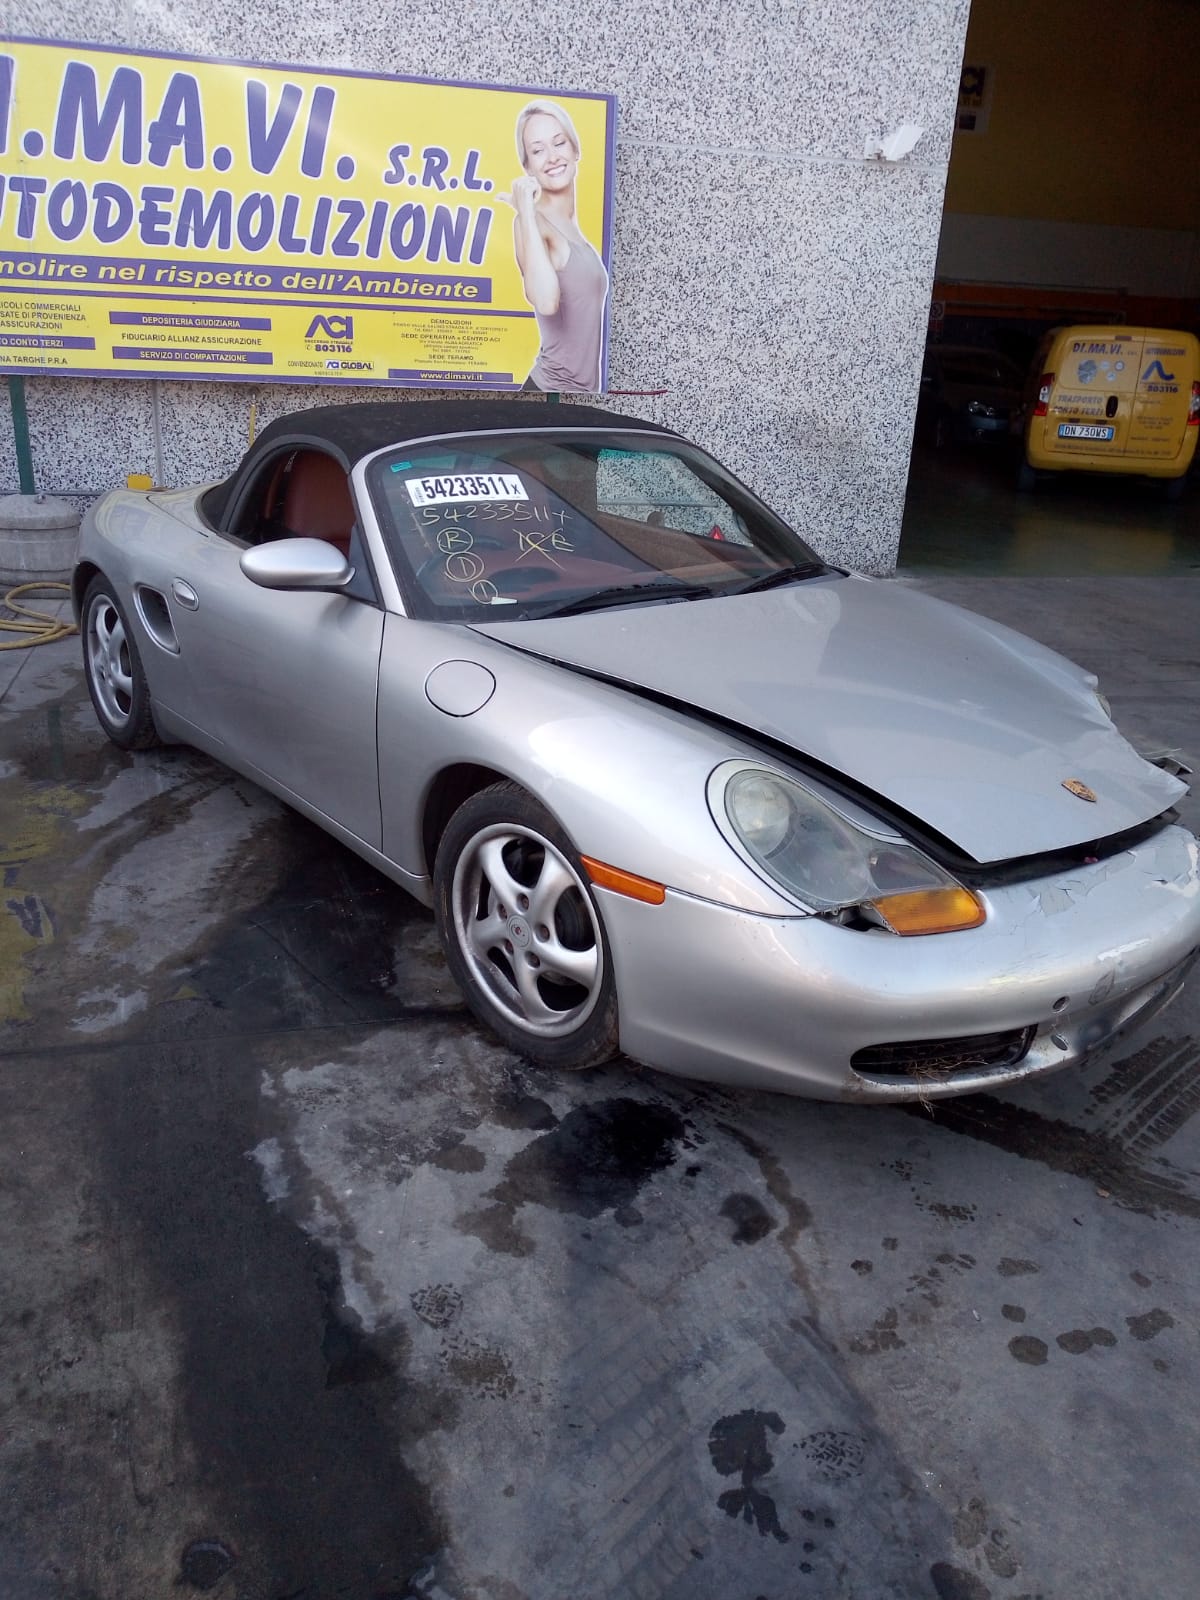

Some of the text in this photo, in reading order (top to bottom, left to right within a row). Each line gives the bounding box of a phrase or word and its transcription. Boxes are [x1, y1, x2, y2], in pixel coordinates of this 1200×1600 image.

[384, 144, 493, 191] S.R.L.
[98, 264, 146, 281] nel
[155, 265, 272, 288] rispetto
[24, 302, 81, 312] COMMERCIALI
[31, 312, 86, 321] PROVENIENZA
[1, 320, 63, 329] ASSICURAZIONI
[142, 316, 241, 328] DEPOSITERIA GIUDIZIARIA
[304, 314, 354, 340] ACI
[10, 338, 39, 346] CONTO
[41, 339, 64, 347] TERZI
[121, 332, 262, 346] FIDUCIARIO ALLIANZ ASSICURAZIONE
[314, 344, 353, 353] 803116
[13, 355, 46, 364] TARGHE
[184, 353, 248, 362] COMPATTAZIONE
[340, 361, 372, 370] GLOBAL
[420, 371, 483, 381] www.dimavi.it
